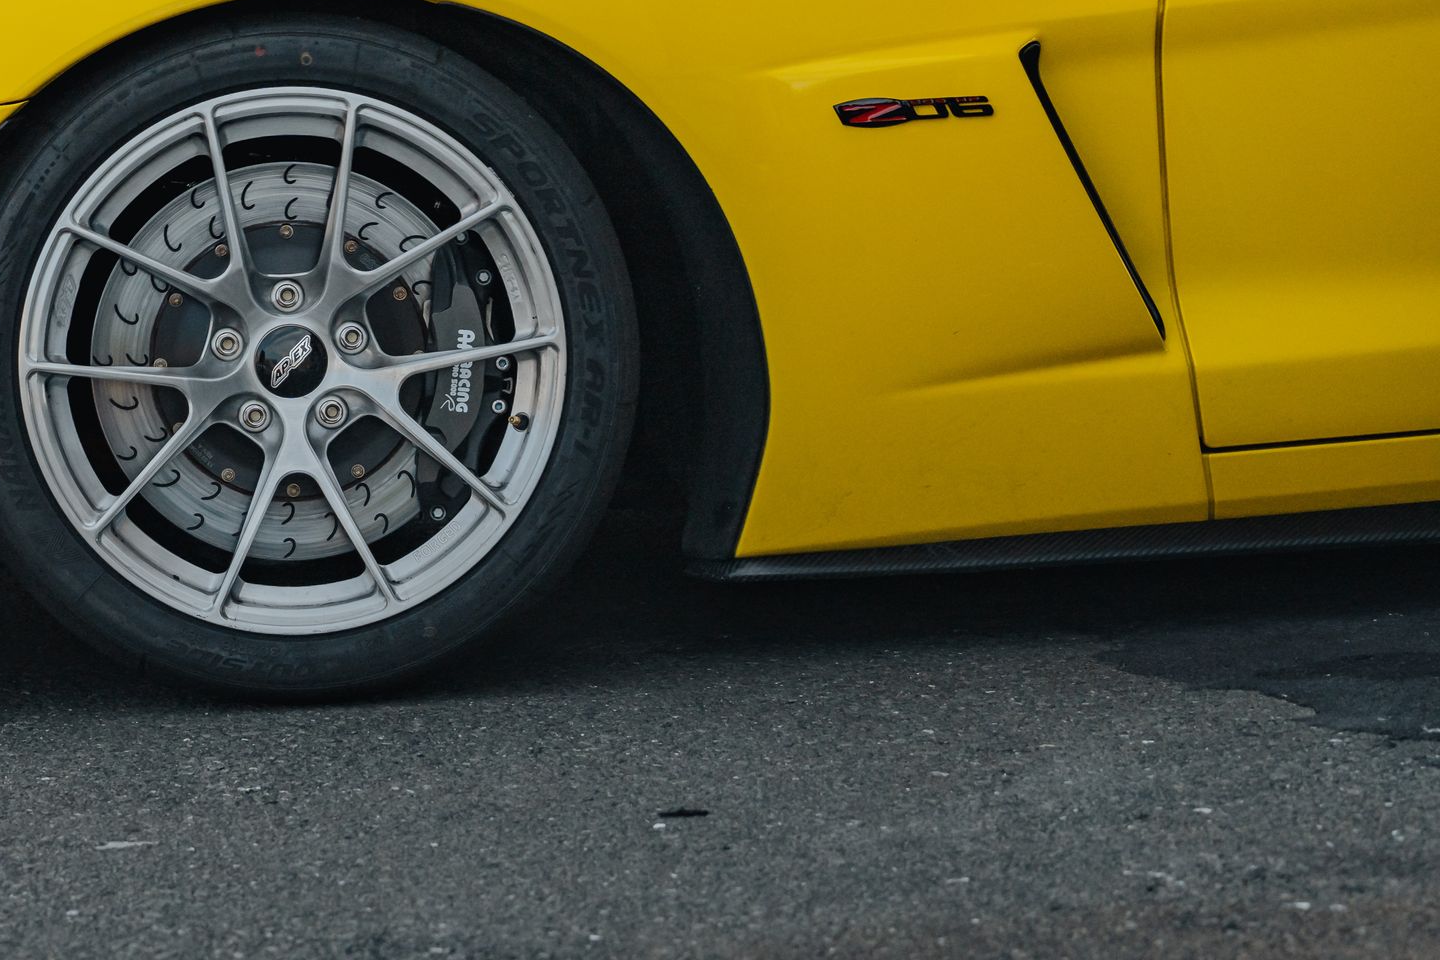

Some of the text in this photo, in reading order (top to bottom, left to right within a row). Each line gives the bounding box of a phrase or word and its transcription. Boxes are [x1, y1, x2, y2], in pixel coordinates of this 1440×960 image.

[834, 96, 994, 128] Z06
[467, 106, 606, 341] SPORTNEX
[271, 335, 312, 388] APEX
[412, 520, 463, 562] FORGED
